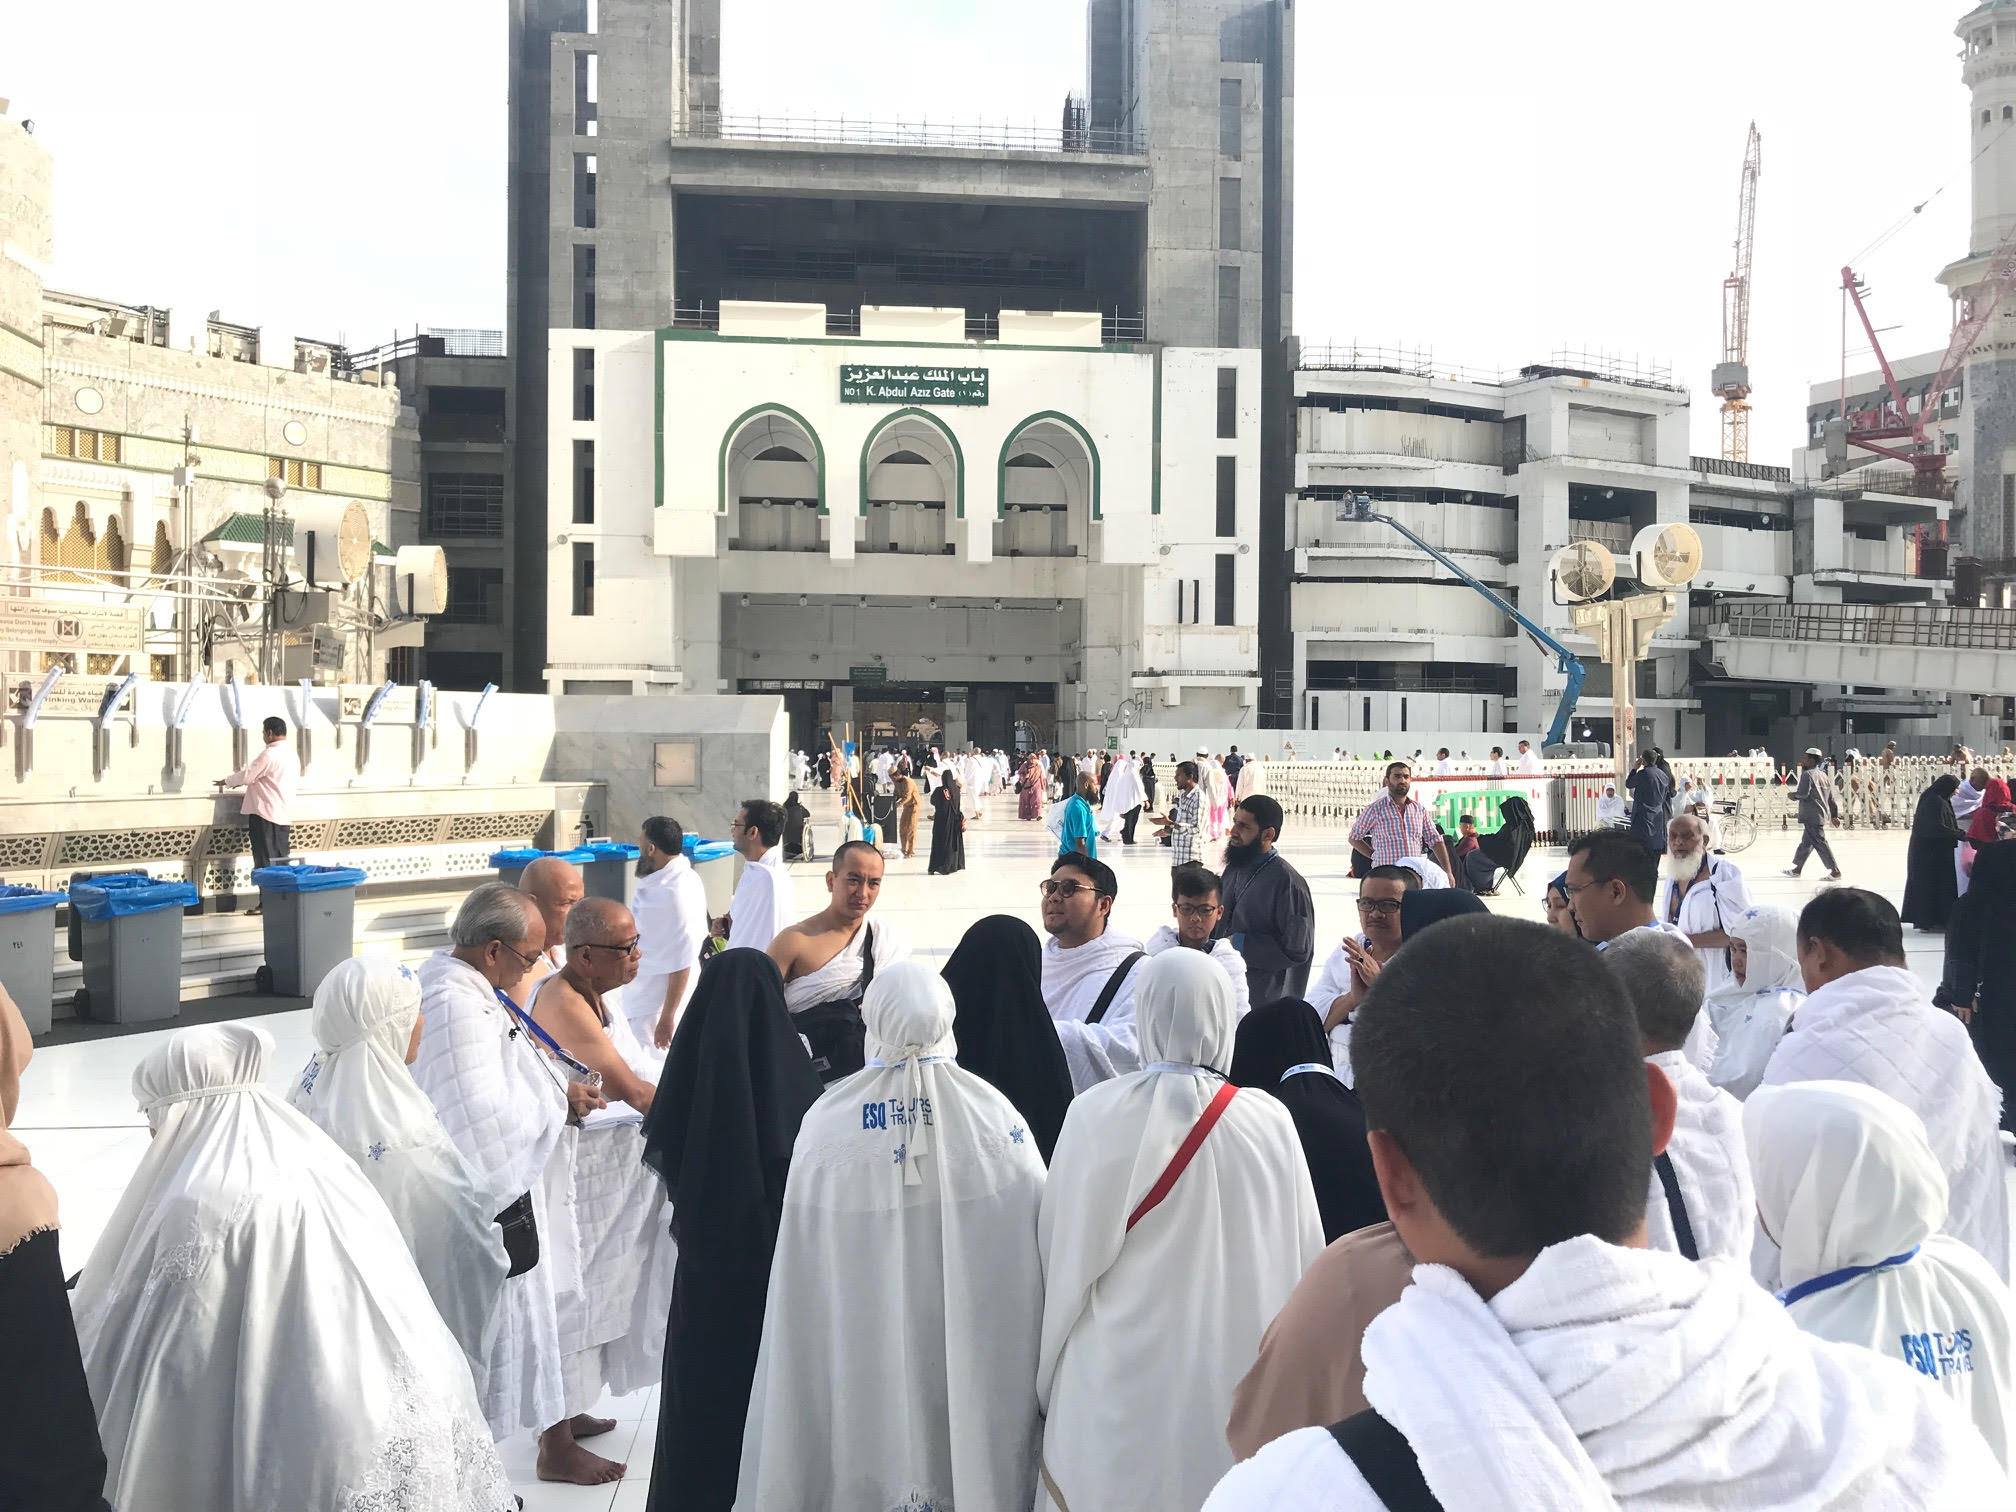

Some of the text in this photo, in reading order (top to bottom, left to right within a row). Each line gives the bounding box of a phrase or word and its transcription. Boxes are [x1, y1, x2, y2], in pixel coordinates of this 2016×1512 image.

[923, 369, 954, 382] الملك
[958, 370, 985, 386] باب
[844, 385, 956, 398] NO 1 K. Abdul Aziz Gate
[862, 1102, 887, 1130] ESQ
